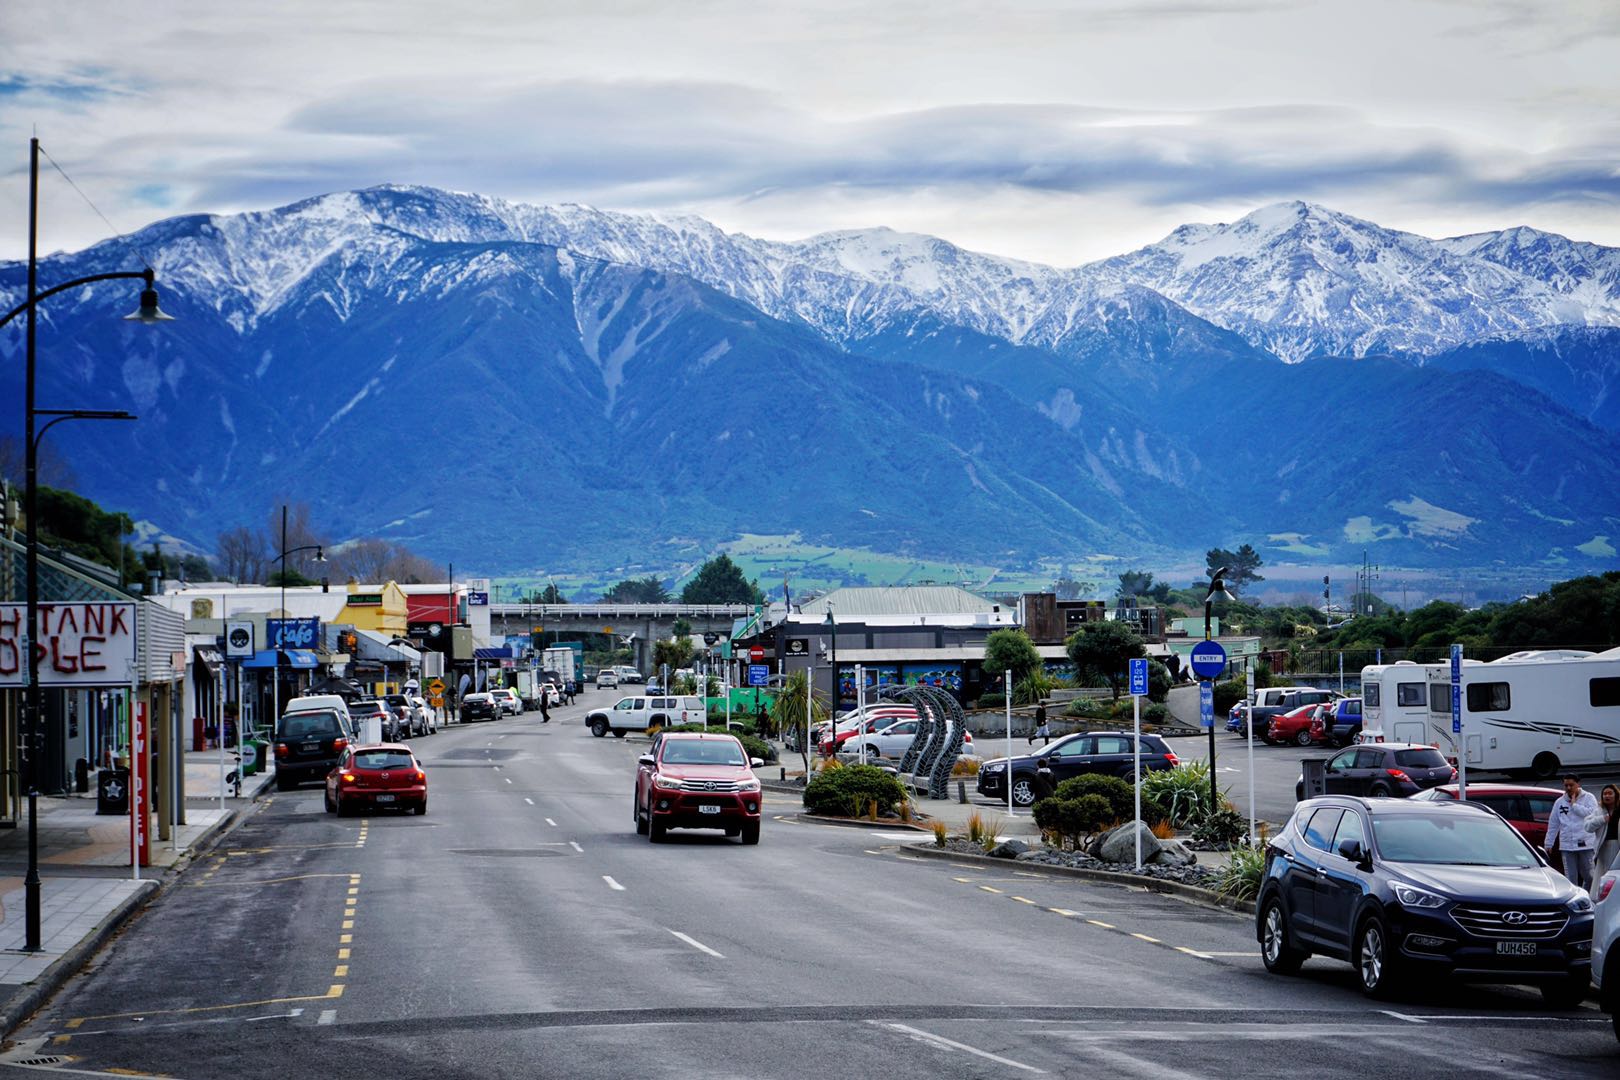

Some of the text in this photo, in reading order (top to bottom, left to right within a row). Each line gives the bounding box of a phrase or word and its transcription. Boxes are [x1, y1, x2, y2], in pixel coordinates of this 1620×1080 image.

[37, 604, 128, 635] TANK
[1135, 660, 1142, 668] P
[1497, 943, 1536, 954] JUH456
